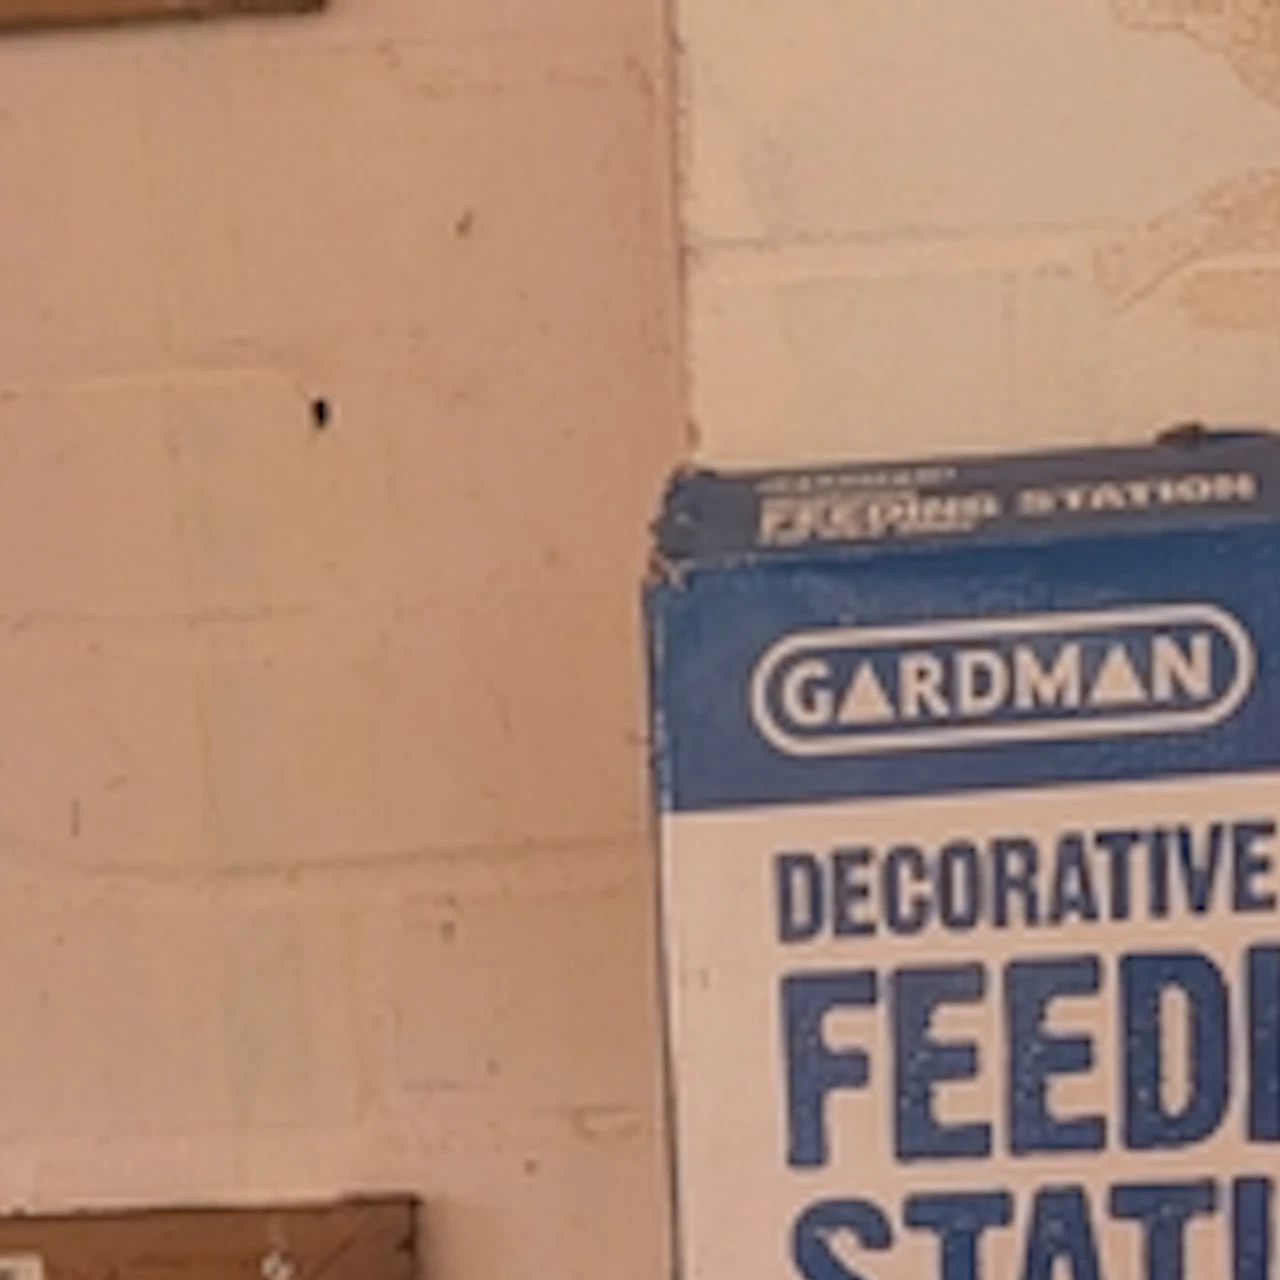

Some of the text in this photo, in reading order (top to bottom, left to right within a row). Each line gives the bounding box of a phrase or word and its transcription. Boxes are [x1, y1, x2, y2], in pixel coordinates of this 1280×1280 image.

[1020, 472, 1258, 516] STATION
[780, 631, 1214, 727] GARDMAN
[775, 821, 1278, 943] DECORATIVE
